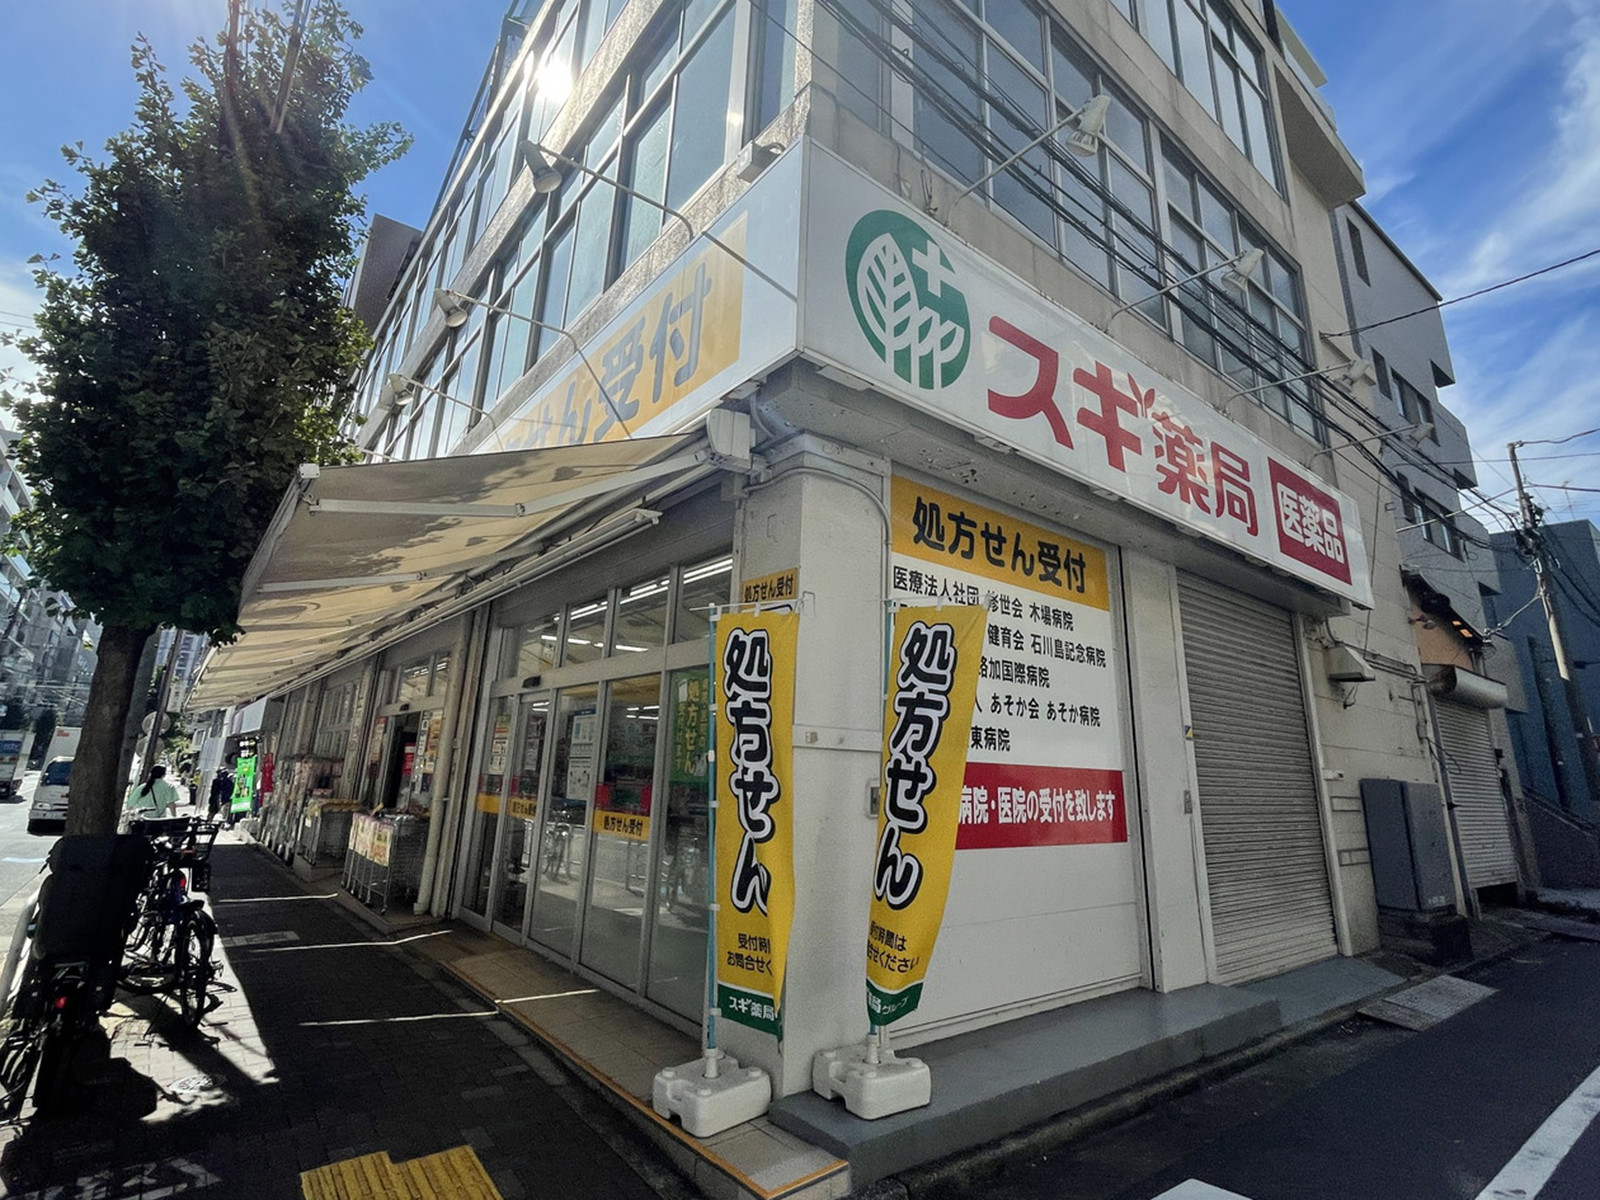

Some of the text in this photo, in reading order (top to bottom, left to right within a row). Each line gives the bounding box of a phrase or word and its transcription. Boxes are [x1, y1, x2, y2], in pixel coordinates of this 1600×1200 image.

[505, 262, 712, 449] せん受付
[988, 316, 1258, 537] スギ薬局
[912, 496, 1085, 593] 処方せん受付
[1277, 482, 1345, 564] 医薬品
[744, 576, 794, 603] 処方せん受付
[893, 565, 979, 605] 医療法人社団
[1029, 602, 1074, 631] 木場病院
[987, 623, 1106, 668] 健育会 石川島記念病院
[991, 692, 1039, 720] あそか会
[1047, 702, 1101, 728] あそか病院
[968, 726, 1011, 751] 東病院
[723, 628, 780, 916] 処方せん
[874, 621, 957, 910] 処方せん
[604, 815, 643, 836] 処方せん受付
[958, 785, 1115, 825] 病院・医院の受付を致します
[738, 933, 771, 954] 受付時
[729, 996, 778, 1021] スギ薬局
